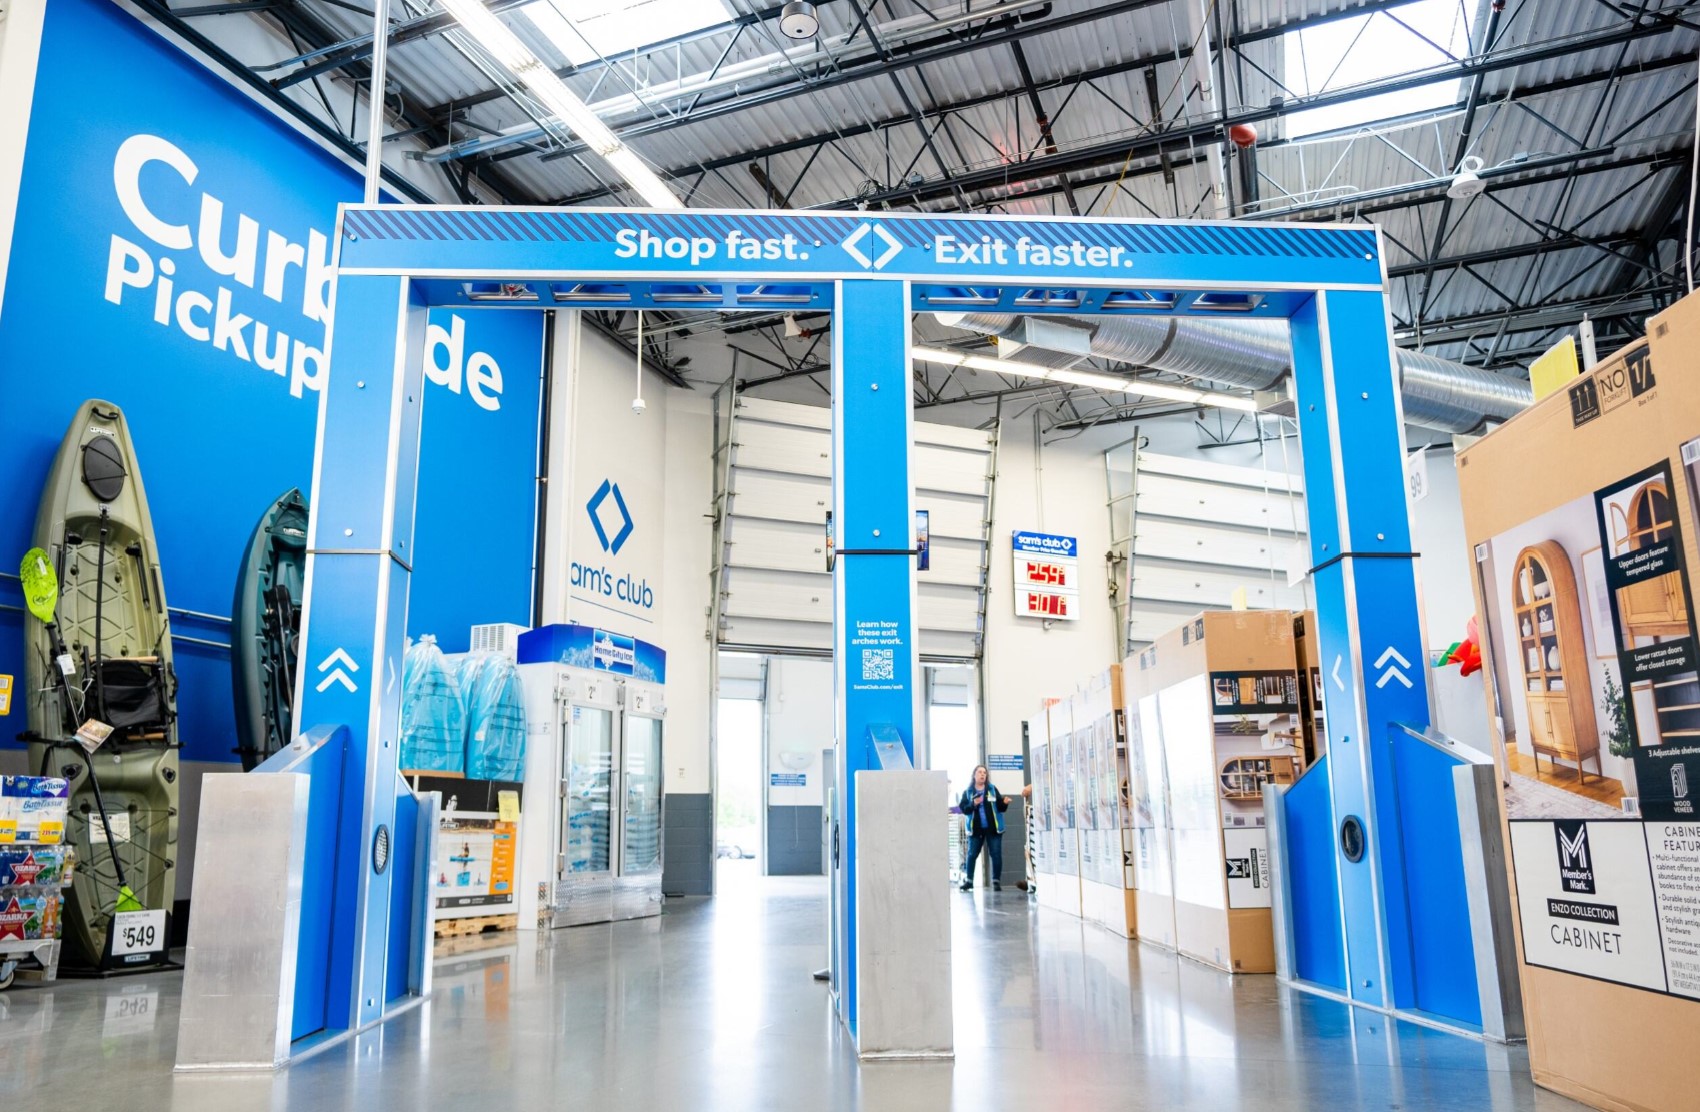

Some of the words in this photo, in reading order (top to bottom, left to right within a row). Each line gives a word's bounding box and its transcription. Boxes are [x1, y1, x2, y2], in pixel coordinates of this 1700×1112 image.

[614, 228, 716, 266] Shop
[725, 230, 809, 260] fast.
[934, 235, 1008, 265] Exit
[1015, 236, 1134, 268] faster.
[113, 133, 503, 411] Curbde
[104, 234, 326, 399] Pickup
[1631, 354, 1652, 389] 1/
[1600, 369, 1625, 396] NO
[1018, 535, 1042, 546] sam's
[1042, 537, 1061, 548] club
[1618, 559, 1634, 569] Upper
[1635, 553, 1649, 563] doors
[1649, 546, 1668, 557] feature
[1626, 562, 1650, 576] tempered
[1650, 559, 1664, 570] glass
[571, 562, 612, 596] am's
[616, 574, 653, 608] club
[856, 620, 879, 628] Learn
[880, 620, 898, 628] how
[1634, 653, 1650, 661] Lower
[1650, 649, 1667, 658] rattan
[1667, 646, 1683, 655] doors
[1635, 663, 1648, 672] offer
[1648, 658, 1665, 669] closed
[1666, 656, 1686, 666] storage
[1648, 749, 1652, 757] 3
[1653, 747, 1681, 758] Adjustable
[1259, 848, 1270, 889] CABINET
[1562, 869, 1592, 881] Member's
[1657, 863, 1676, 871] cabinet
[1677, 864, 1693, 872] offers
[1658, 872, 1687, 881] abundance
[1570, 880, 1586, 890] Mark
[1659, 881, 1676, 889] books
[1683, 882, 1694, 891] fine
[1662, 894, 1682, 902] Durable
[1551, 903, 1569, 914] ENZO
[1571, 905, 1616, 920] COLLECTION
[1673, 905, 1691, 914] stylish
[1665, 916, 1683, 925] Stylish
[123, 925, 155, 948] $549
[1666, 926, 1691, 935] hardware
[1551, 924, 1622, 955] CABINET
[1668, 938, 1693, 947] Decorative
